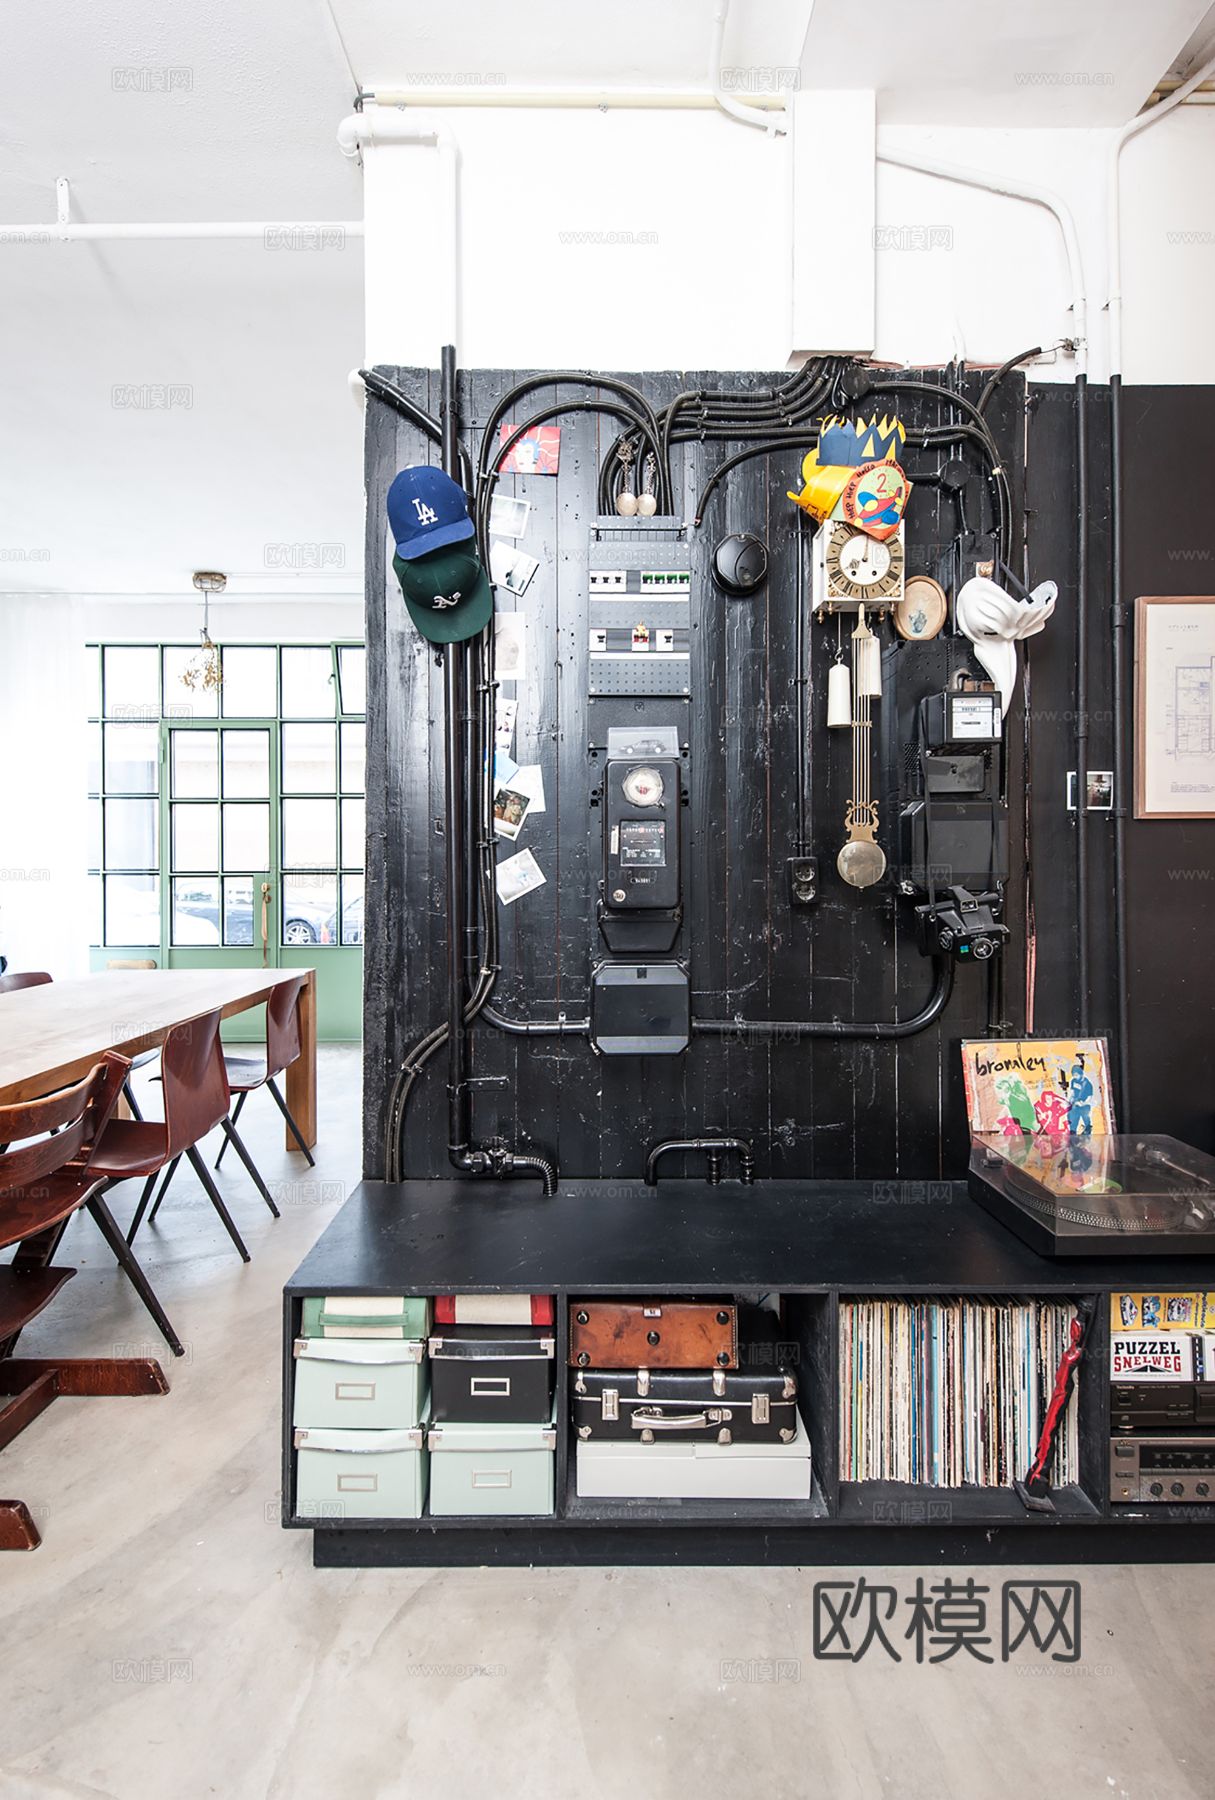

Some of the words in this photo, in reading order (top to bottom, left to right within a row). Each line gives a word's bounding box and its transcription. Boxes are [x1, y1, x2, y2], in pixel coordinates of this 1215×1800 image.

[876, 473, 887, 493] 2
[412, 498, 438, 526] LA
[975, 1052, 1046, 1076] bromley
[1114, 1341, 1180, 1355] PUZZEL
[1113, 1356, 1182, 1373] SNELWEG
